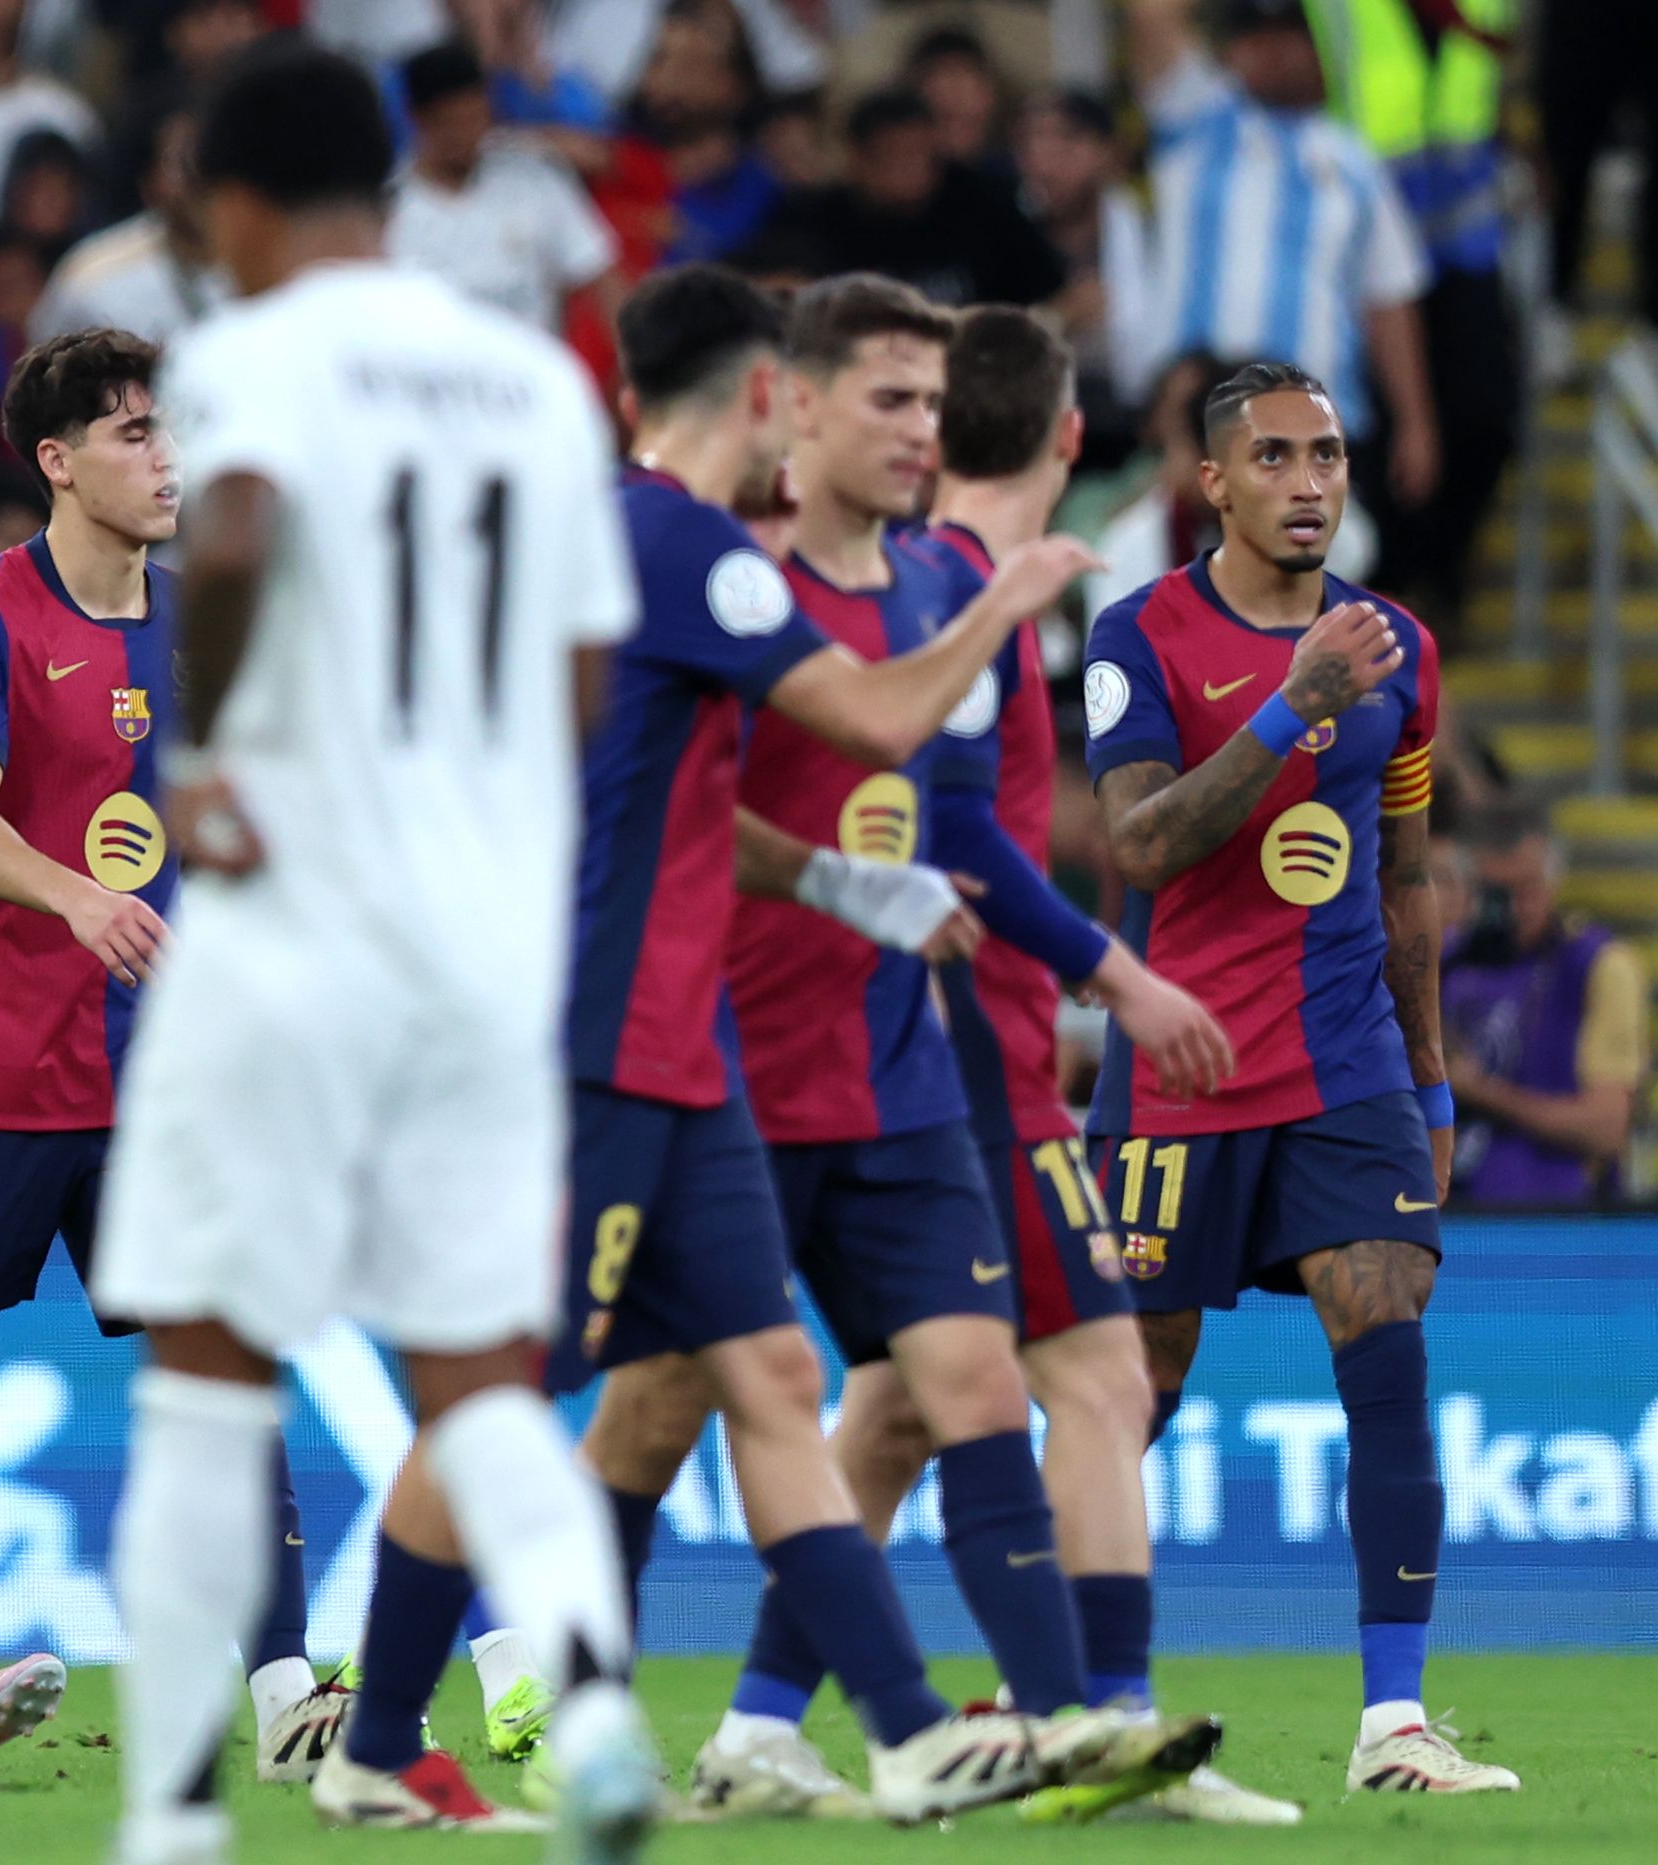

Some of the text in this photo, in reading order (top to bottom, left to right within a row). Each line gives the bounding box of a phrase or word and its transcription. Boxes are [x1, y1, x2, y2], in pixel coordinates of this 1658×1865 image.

[374, 460, 512, 738] 11
[1118, 1137, 1188, 1231] 11
[588, 1202, 642, 1304] 8
[1244, 1393, 1658, 1543] Tka
